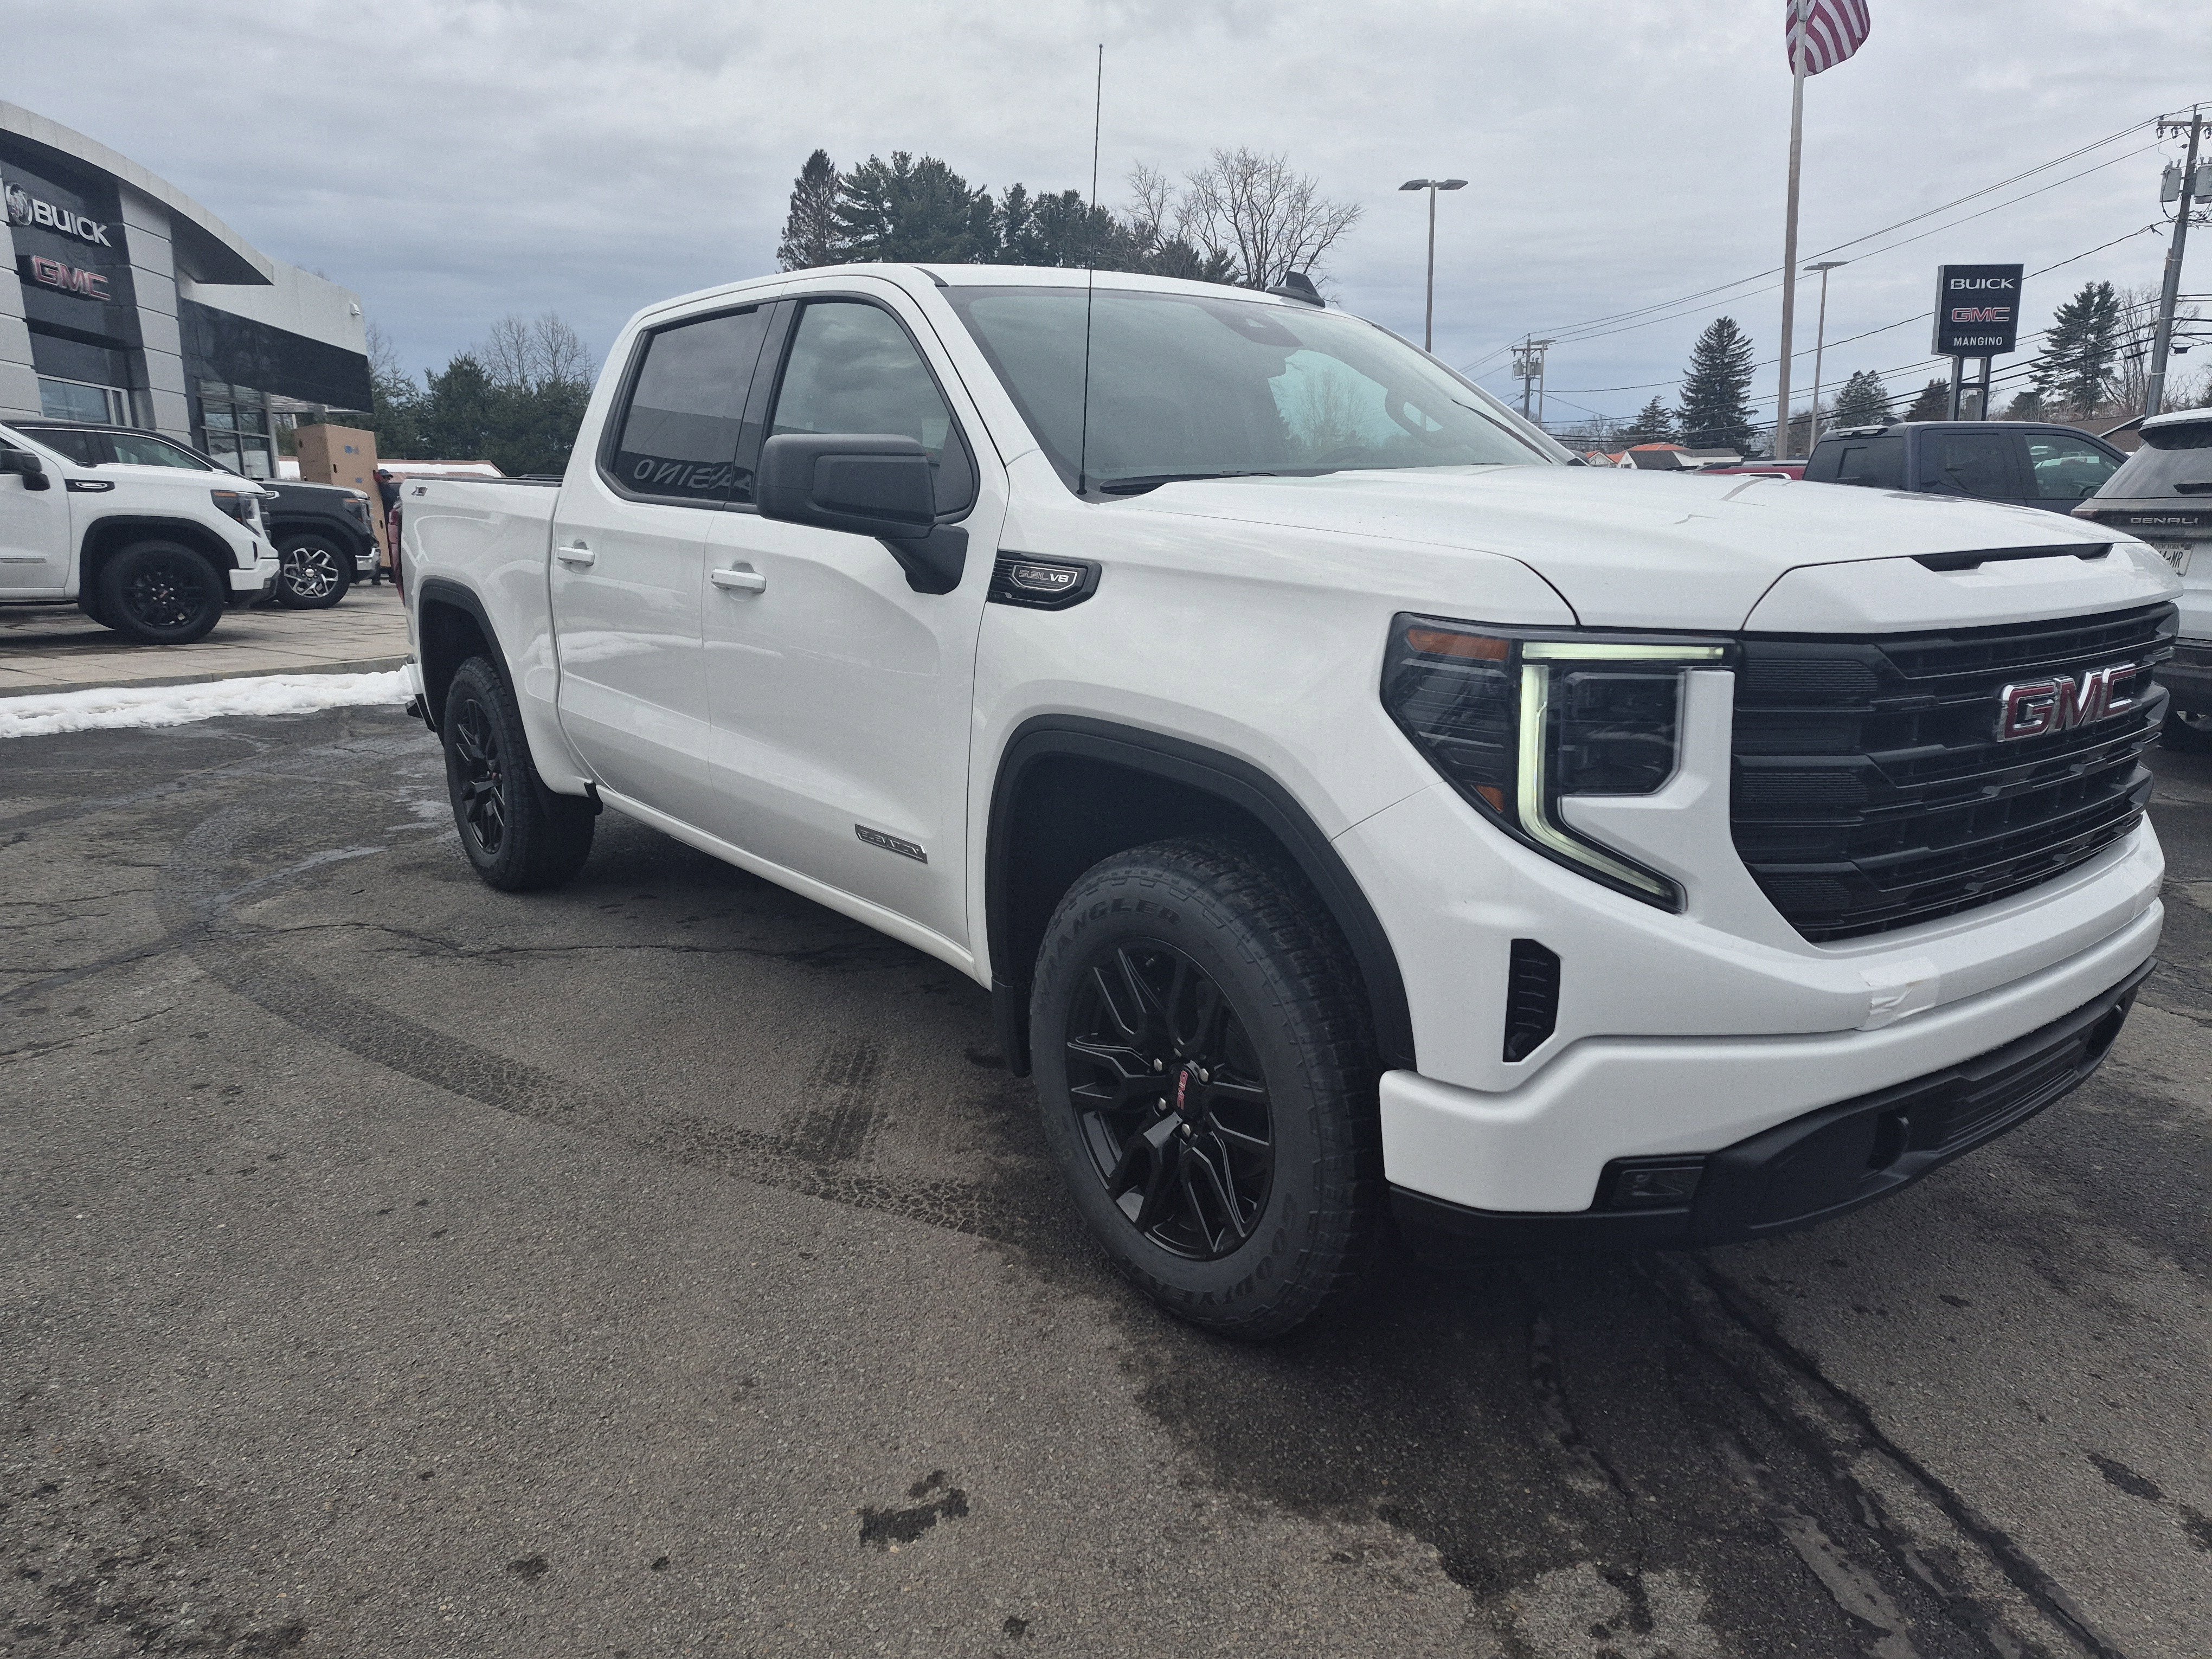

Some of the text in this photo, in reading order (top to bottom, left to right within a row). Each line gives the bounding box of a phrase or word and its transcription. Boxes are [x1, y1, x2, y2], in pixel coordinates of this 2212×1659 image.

[33, 198, 112, 248] BUICK
[32, 255, 111, 301] GMC
[1950, 278, 2016, 290] BUICK
[1952, 307, 2010, 322] GMC
[1953, 336, 2003, 346] MANGINO
[1050, 573, 1069, 583] V8
[1997, 663, 2137, 742] GMC
[1177, 1070, 1188, 1110] GMC
